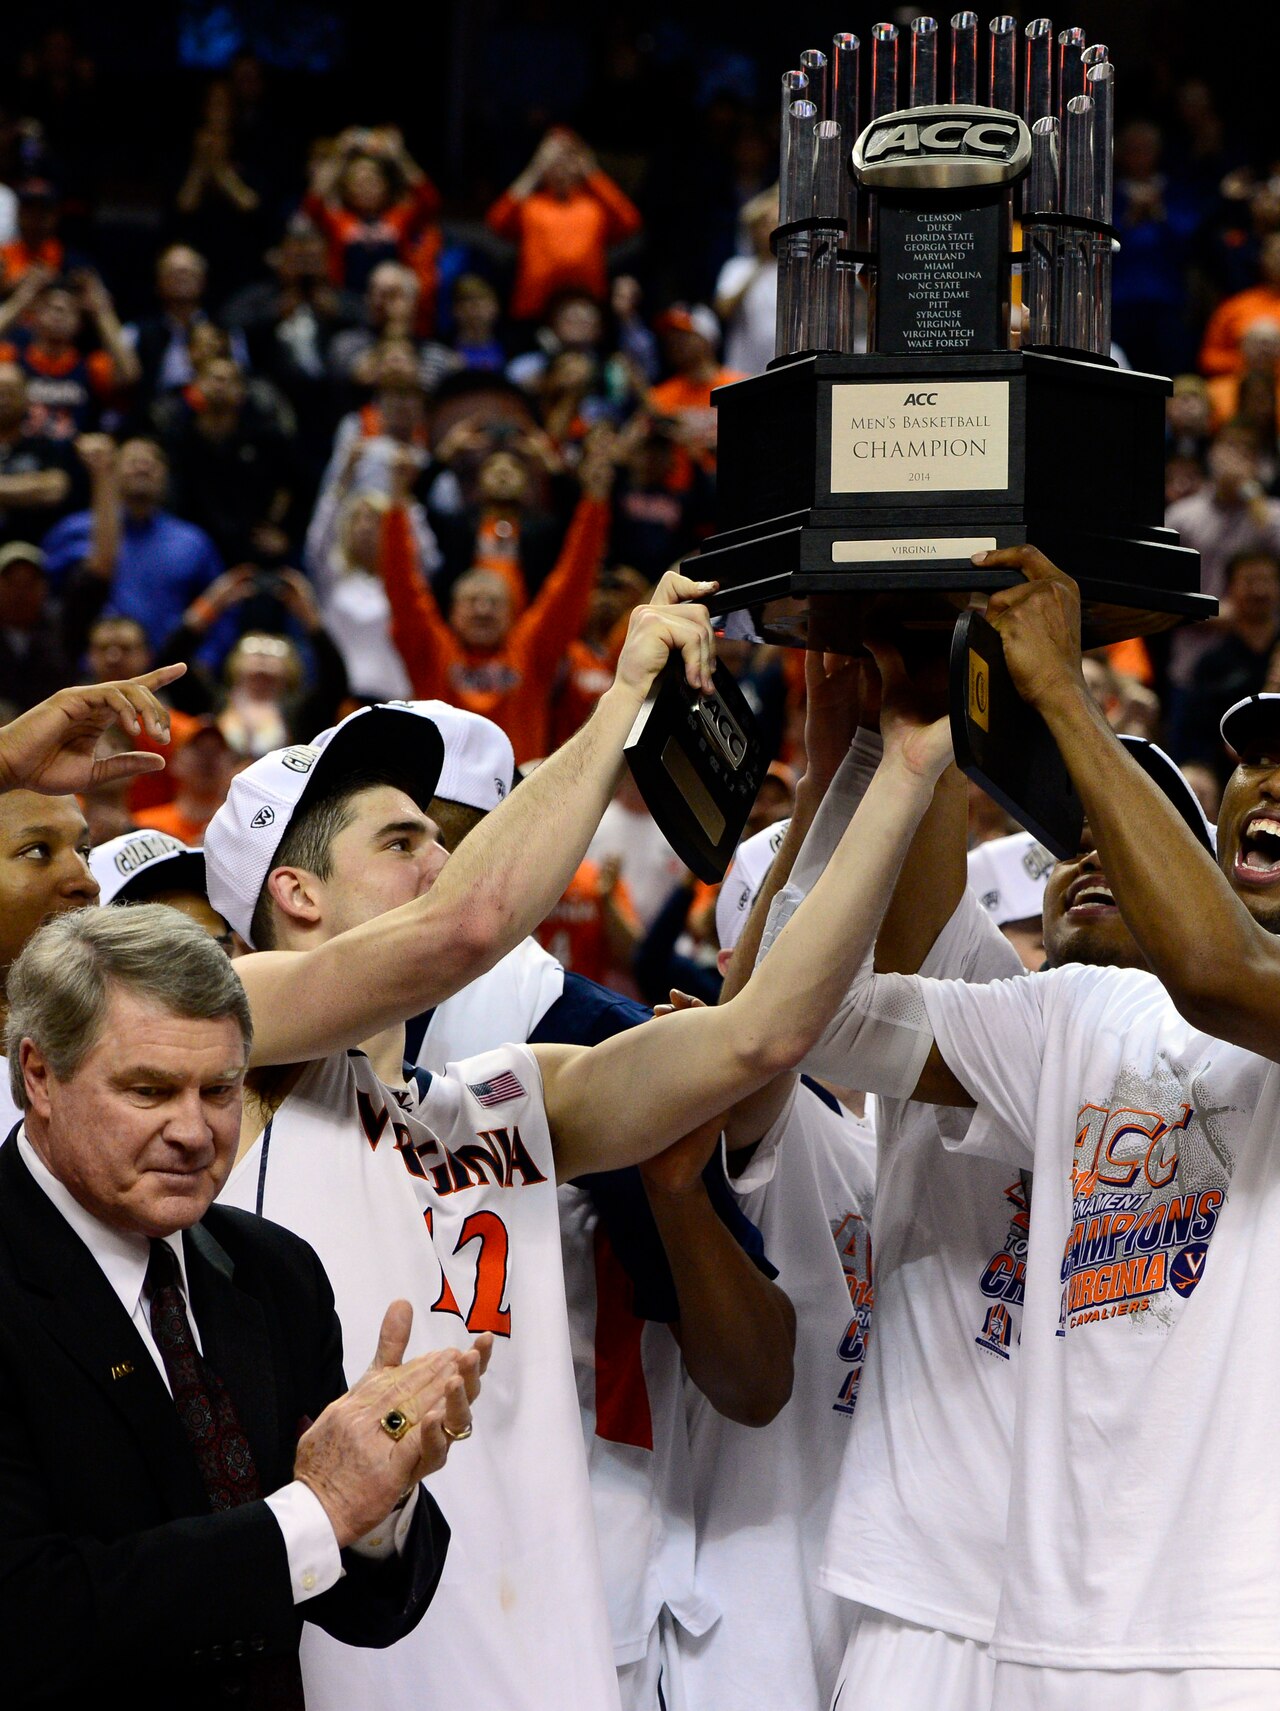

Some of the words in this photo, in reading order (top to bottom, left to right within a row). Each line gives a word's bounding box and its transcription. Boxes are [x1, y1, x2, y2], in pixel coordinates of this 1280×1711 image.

[865, 120, 1018, 159] ACC
[916, 213, 962, 222] CLEMSON
[926, 223, 953, 232] DUKE
[905, 233, 945, 242] FLORIDA
[947, 232, 974, 241] STATE
[904, 243, 947, 251] GEORGIA
[949, 242, 974, 250] TECH
[913, 252, 966, 261] MARYLAND
[924, 262, 954, 270] MIAMI
[897, 272, 931, 280] NORTH
[933, 271, 982, 279] CAROLINA
[917, 281, 932, 290] NC
[934, 281, 961, 289] STATE
[908, 291, 940, 299] NOTRE
[943, 290, 970, 298] DAME
[929, 300, 949, 309] PITT
[916, 310, 962, 319] SYRACUSE
[916, 320, 962, 328] VIRGINIA
[902, 330, 947, 338] VIRGINIA
[949, 329, 974, 337] TECH
[907, 340, 933, 348] WAKE
[936, 339, 970, 347] FOREST
[903, 392, 938, 406] ACC
[852, 438, 987, 459] CHAMPION
[908, 472, 931, 482] 2014
[891, 545, 937, 554] VIRGINIA
[702, 700, 745, 761] ACC
[1069, 1298, 1151, 1330] CAVALIERS
